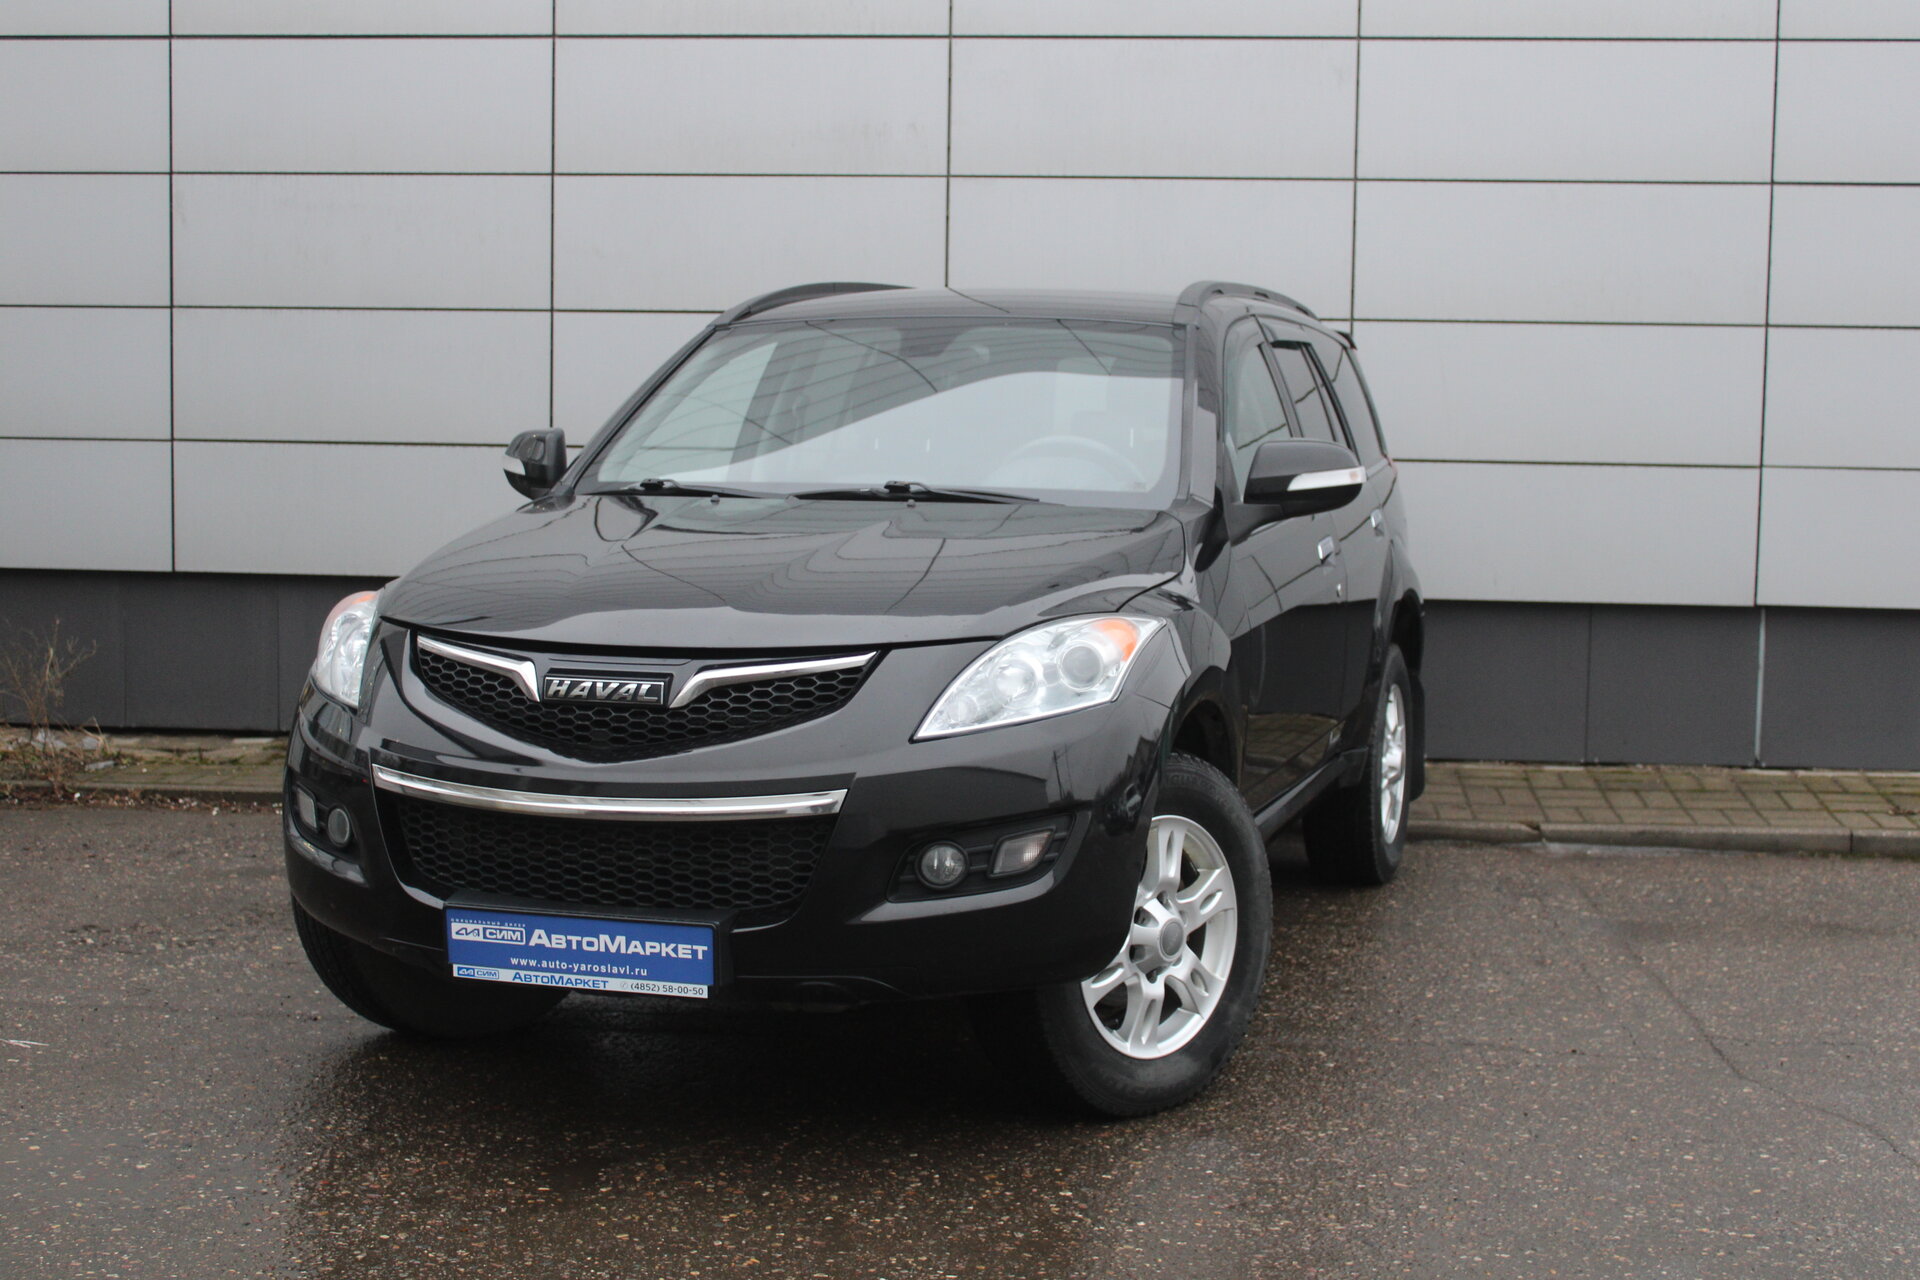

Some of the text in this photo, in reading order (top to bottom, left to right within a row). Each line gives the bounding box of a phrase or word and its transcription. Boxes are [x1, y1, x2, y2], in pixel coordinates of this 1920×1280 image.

[547, 680, 659, 702] HAVAL
[486, 929, 521, 941] СИМ
[510, 957, 648, 976] www.auto-yaroslavl.ru
[630, 982, 661, 992] (4852)
[662, 985, 704, 996] 58-00-50
